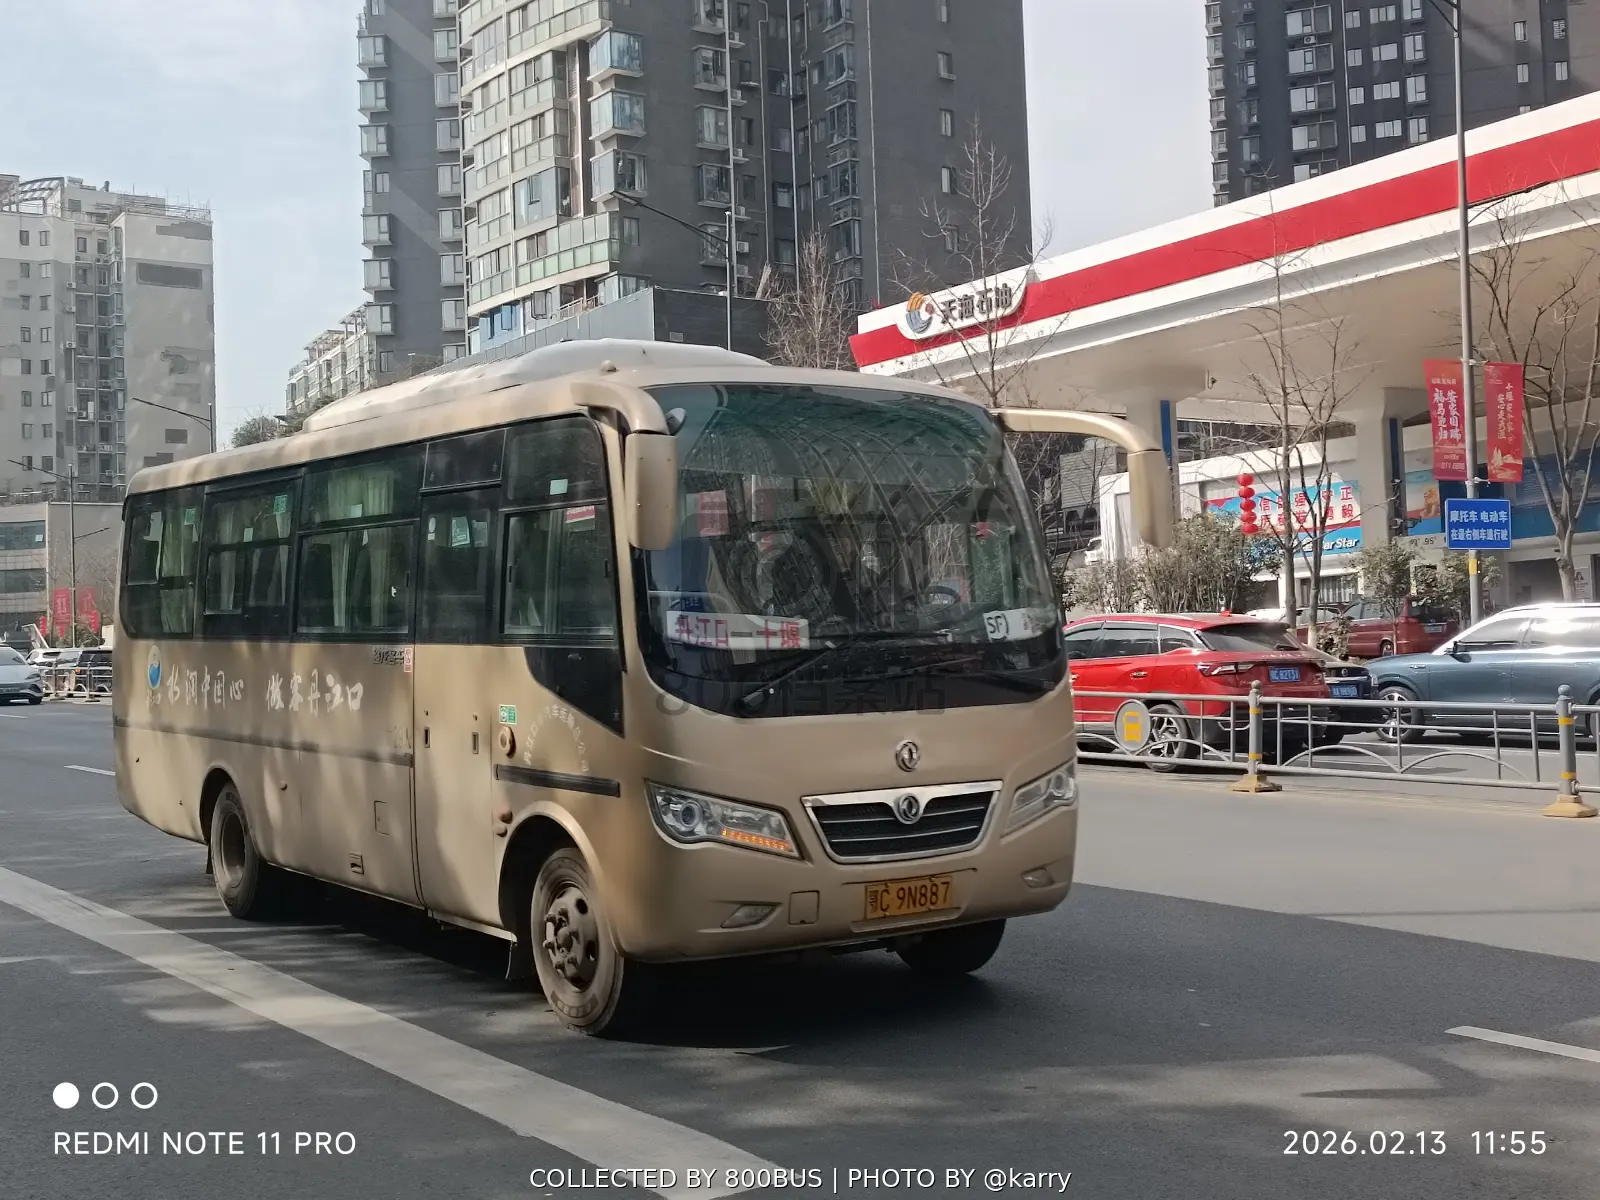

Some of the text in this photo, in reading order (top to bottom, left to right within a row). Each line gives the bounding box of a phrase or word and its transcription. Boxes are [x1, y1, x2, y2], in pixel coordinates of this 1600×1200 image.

[1450, 510, 1509, 524] 摩托车 电动车
[1450, 528, 1509, 541] 在最右侧车道行驶
[1336, 537, 1359, 549] Star
[896, 882, 950, 910] 9N887
